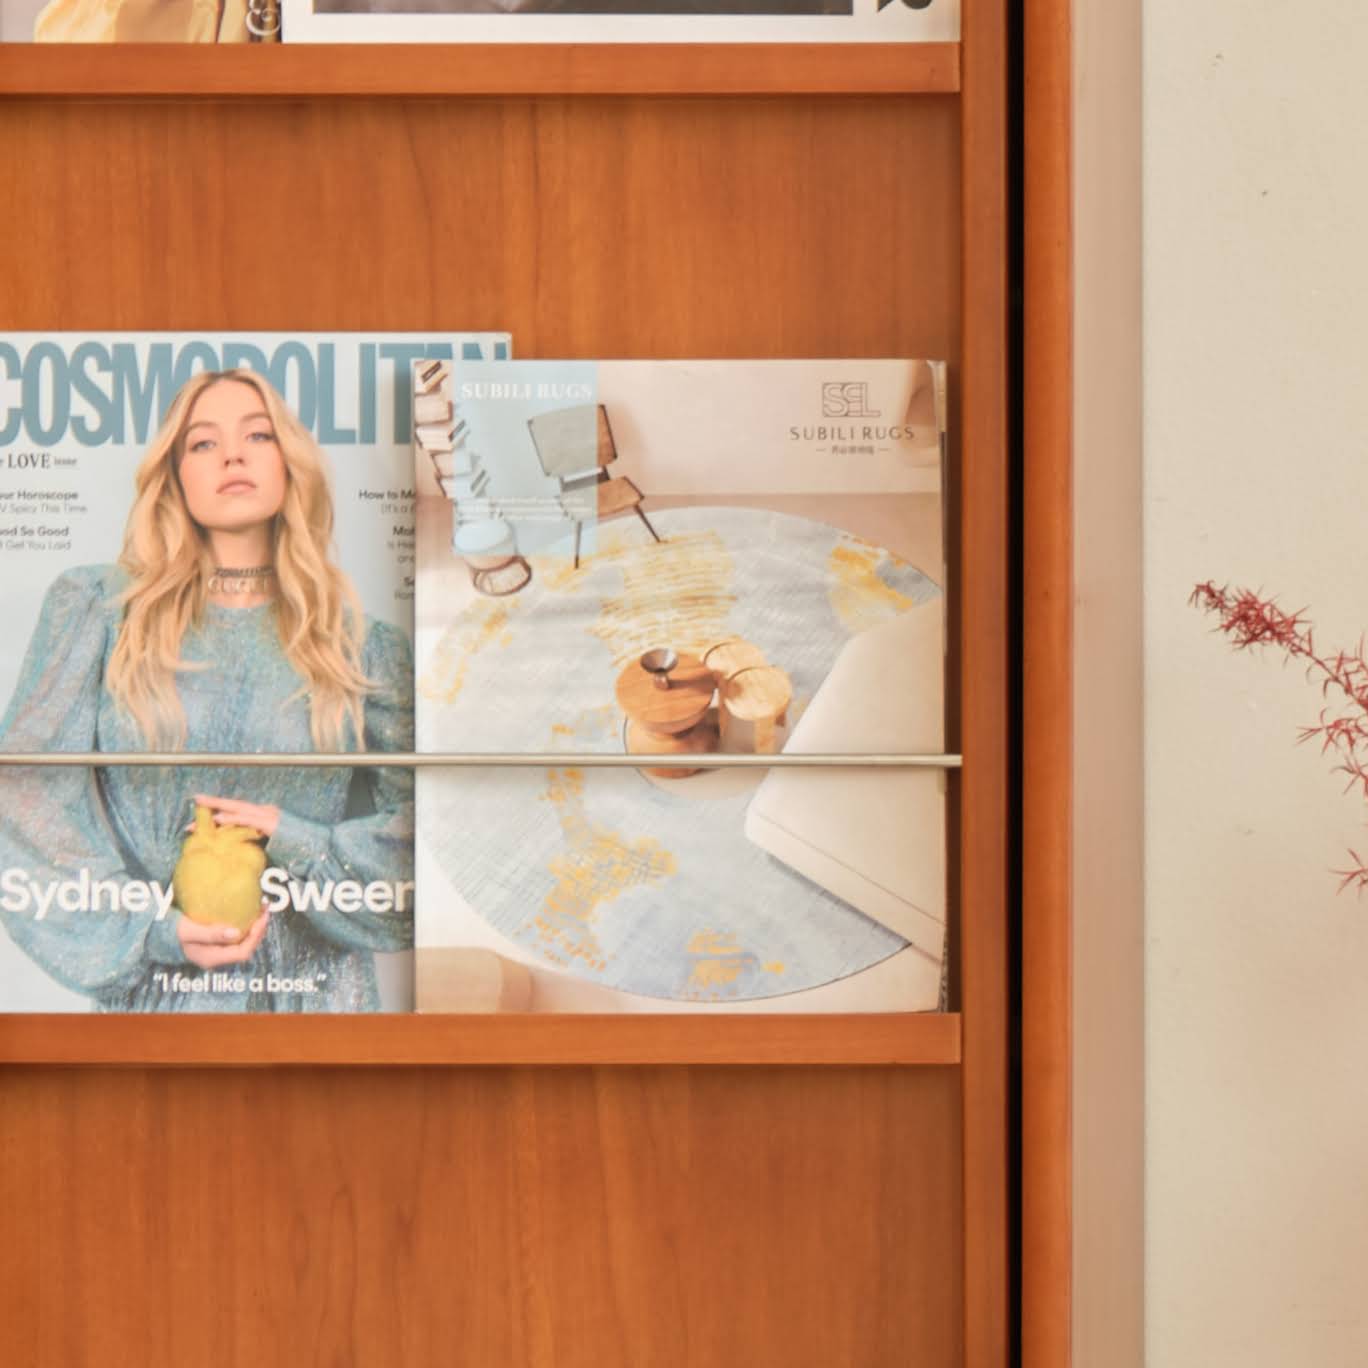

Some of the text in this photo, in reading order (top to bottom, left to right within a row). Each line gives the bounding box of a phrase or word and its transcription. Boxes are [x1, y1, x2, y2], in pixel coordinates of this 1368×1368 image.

[461, 383, 532, 400] SUBILI
[789, 426, 916, 441] SUBILI RUGS
[7, 453, 51, 470] LOVE
[17, 490, 79, 502] Horoscope
[358, 488, 385, 500] How
[20, 525, 35, 537] So
[37, 525, 70, 537] Good
[0, 867, 174, 921] Sydney
[172, 971, 210, 993] feel
[212, 971, 246, 993] like
[248, 977, 264, 993] a
